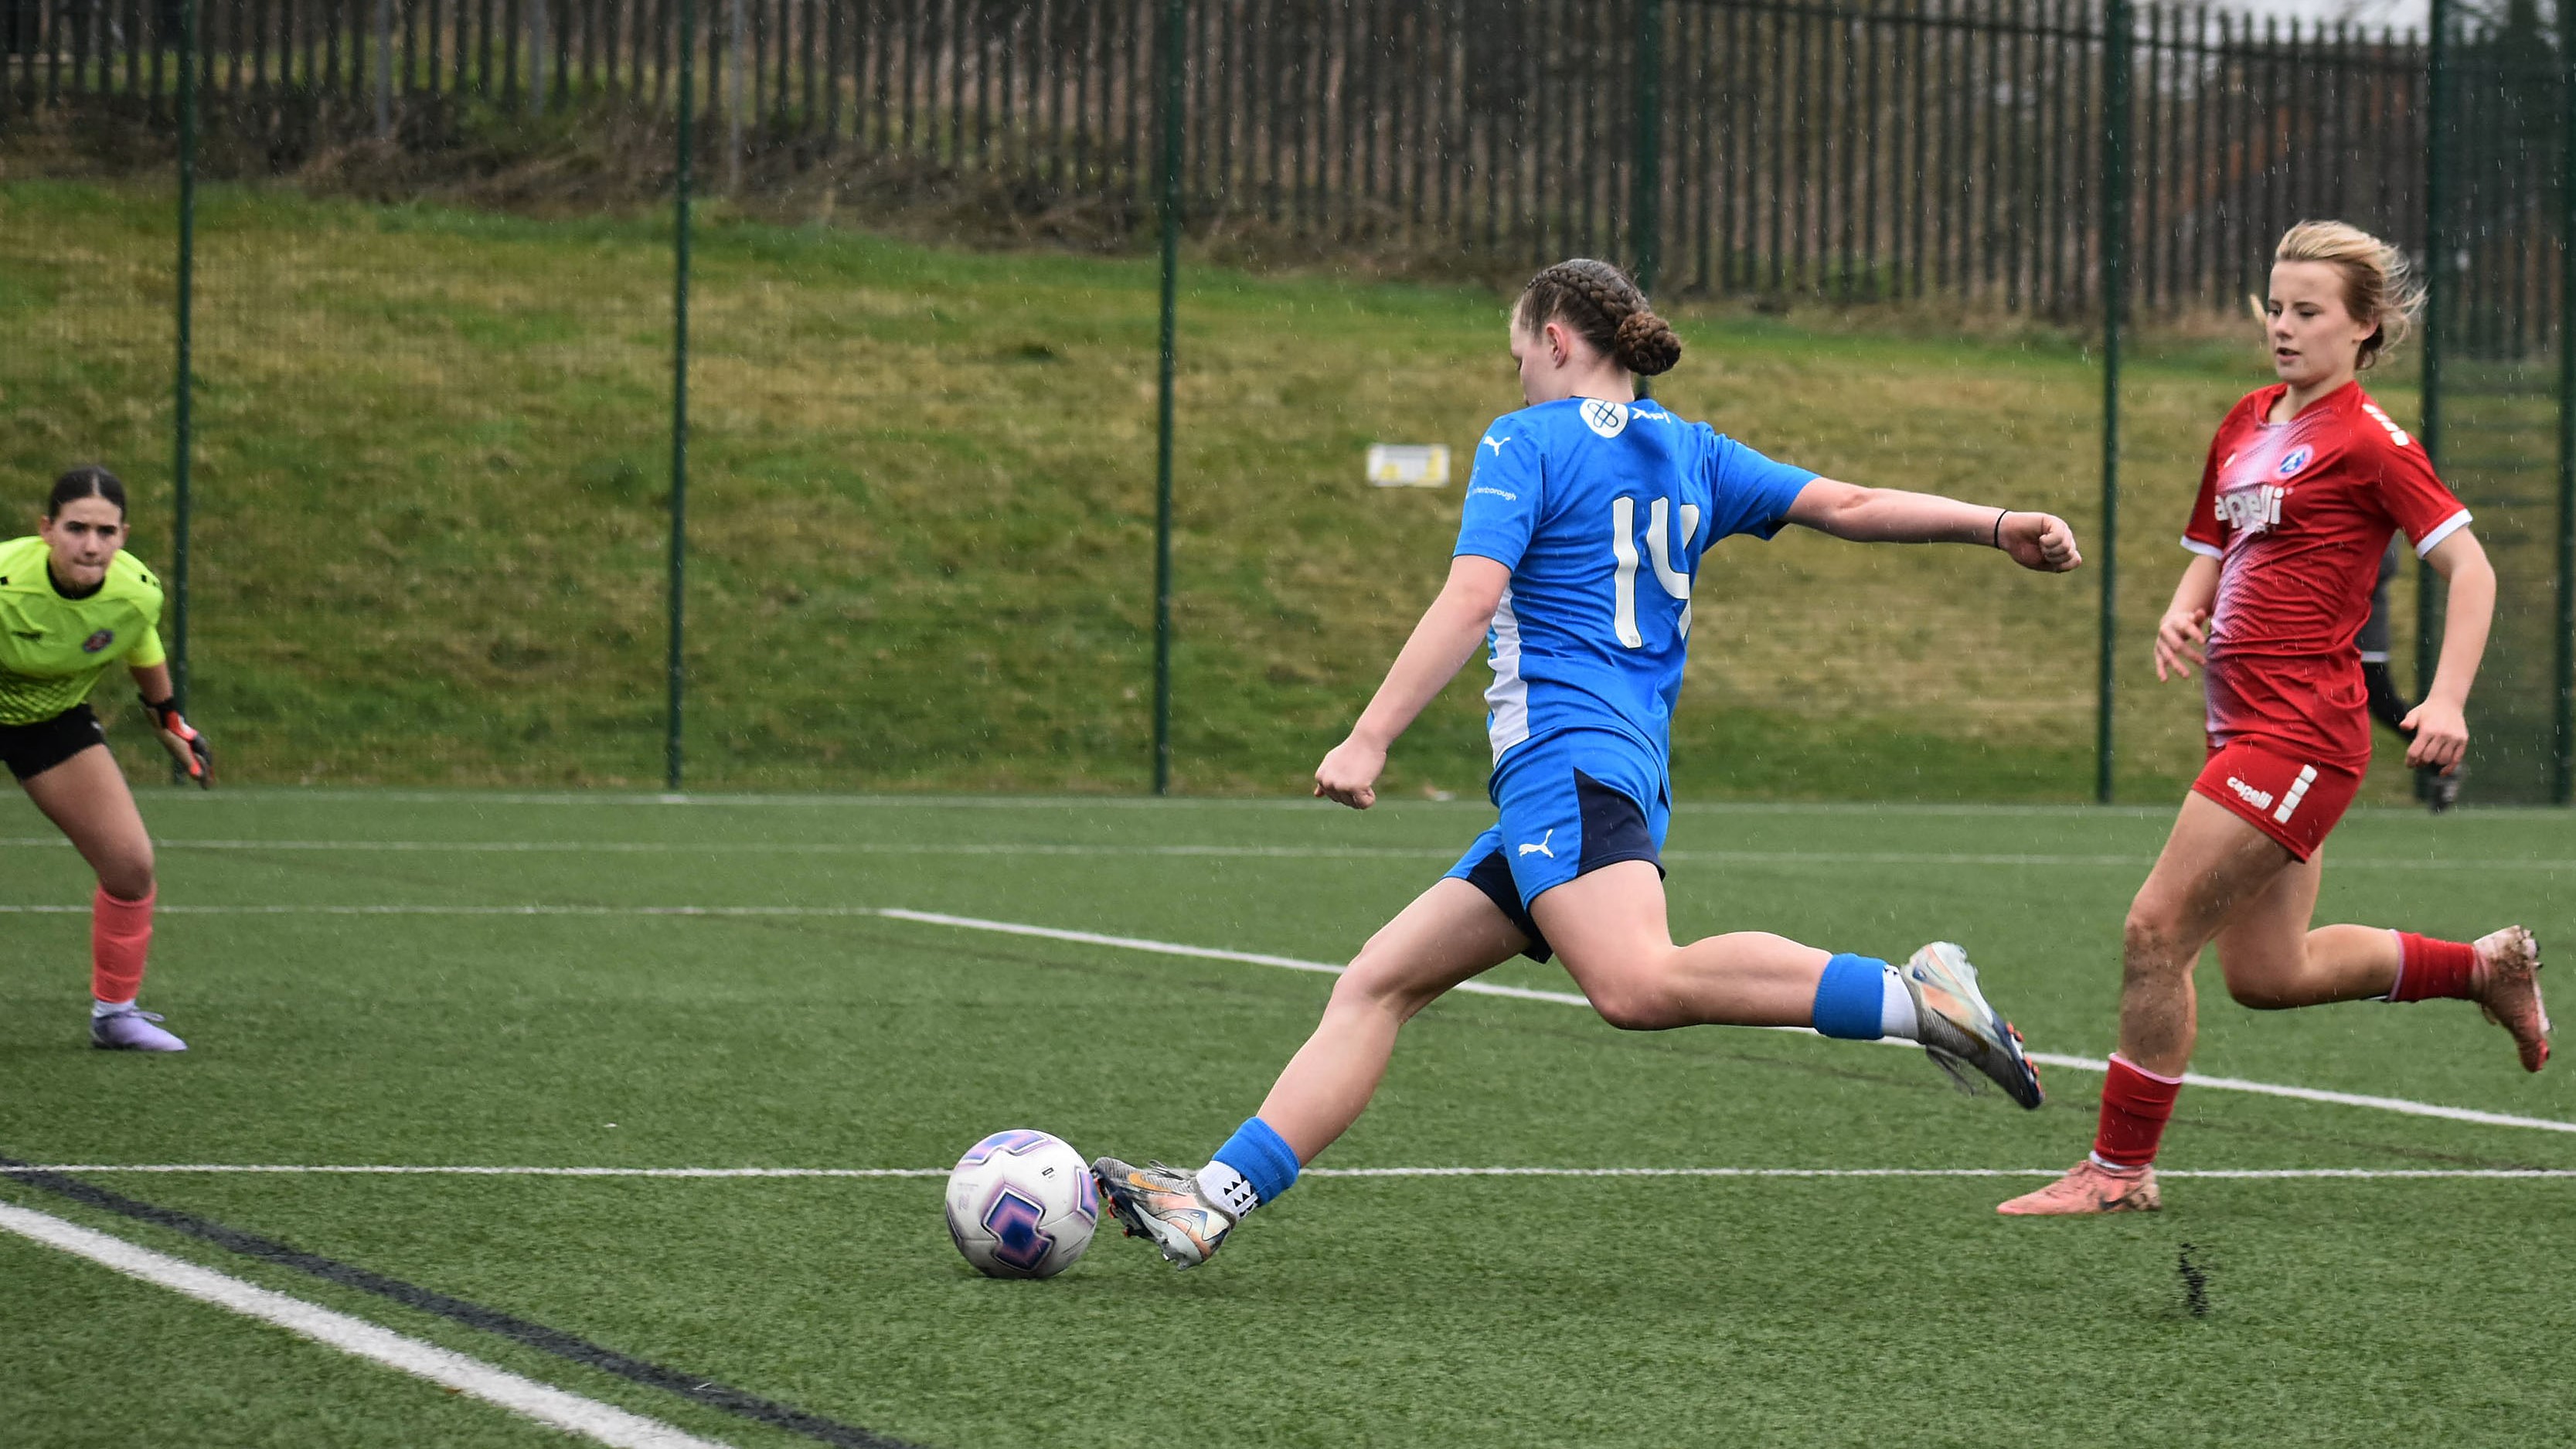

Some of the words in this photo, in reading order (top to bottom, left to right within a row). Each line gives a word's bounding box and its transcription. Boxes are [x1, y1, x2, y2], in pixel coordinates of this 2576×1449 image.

[2214, 485, 2285, 529] apelli
[1612, 496, 1700, 648] 14
[2227, 776, 2273, 811] capelli
